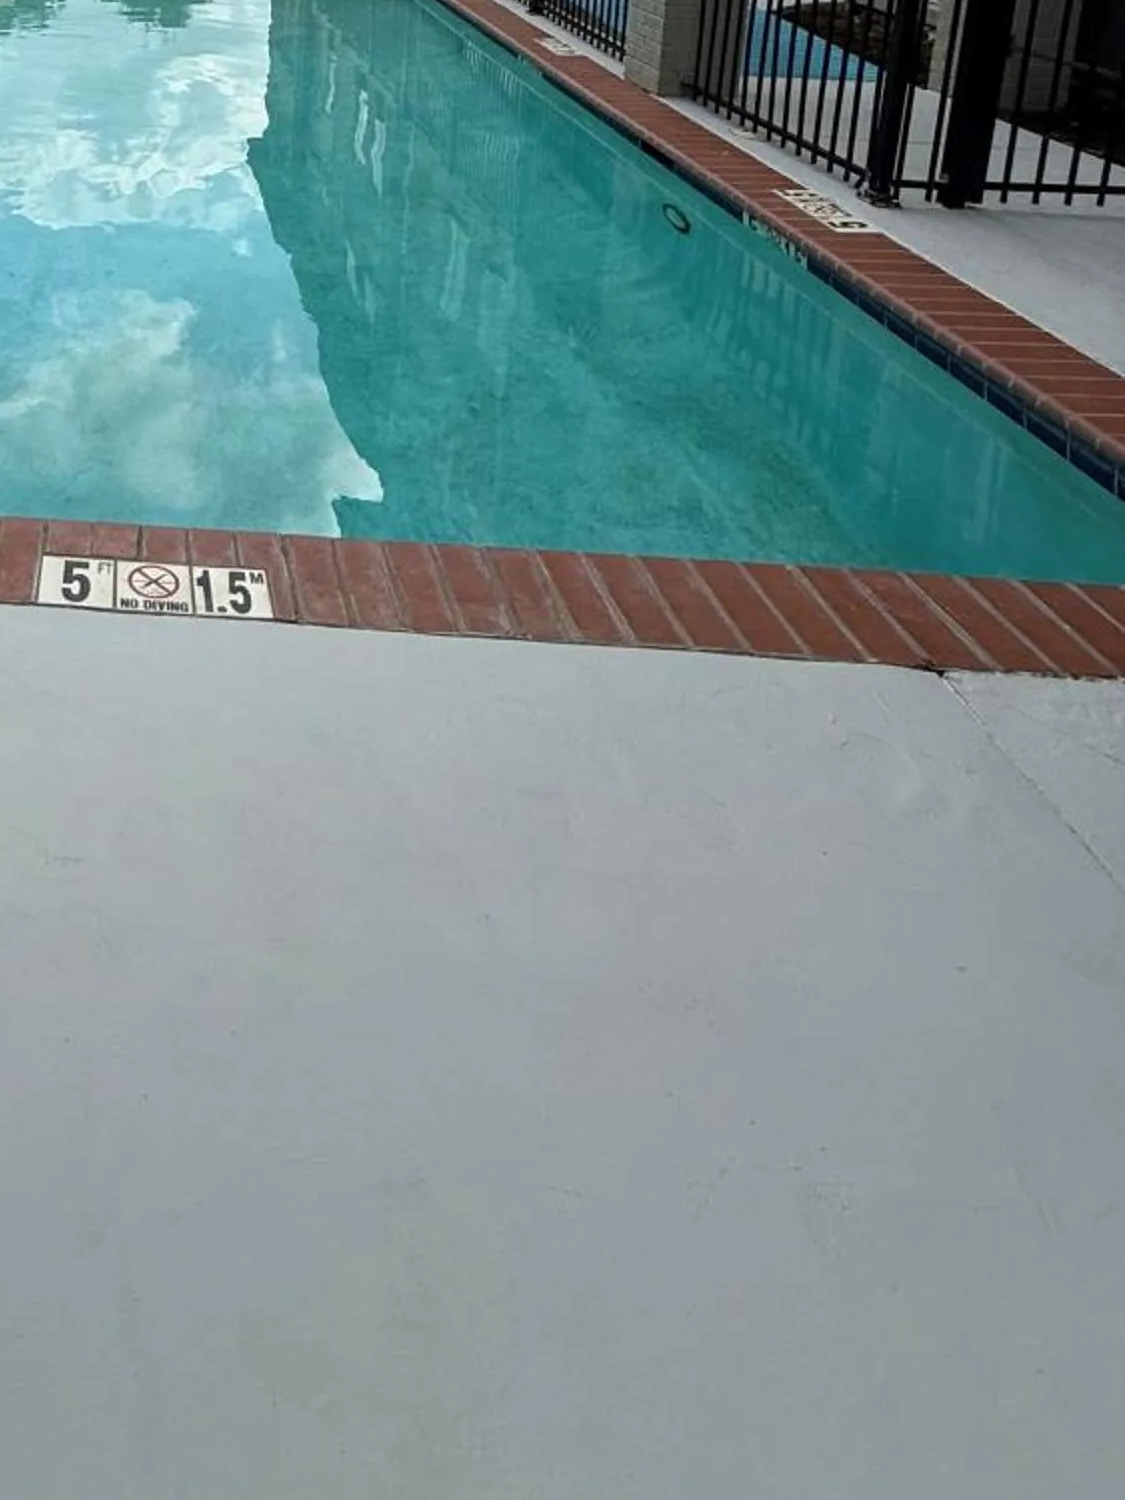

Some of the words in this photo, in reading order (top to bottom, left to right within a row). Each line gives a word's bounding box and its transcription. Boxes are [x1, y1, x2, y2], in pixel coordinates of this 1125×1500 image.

[61, 559, 92, 603] 5
[97, 562, 112, 575] FT
[195, 569, 253, 615] 1.5
[249, 571, 264, 585] M
[120, 597, 139, 609] NO
[143, 599, 189, 613] DIVING
